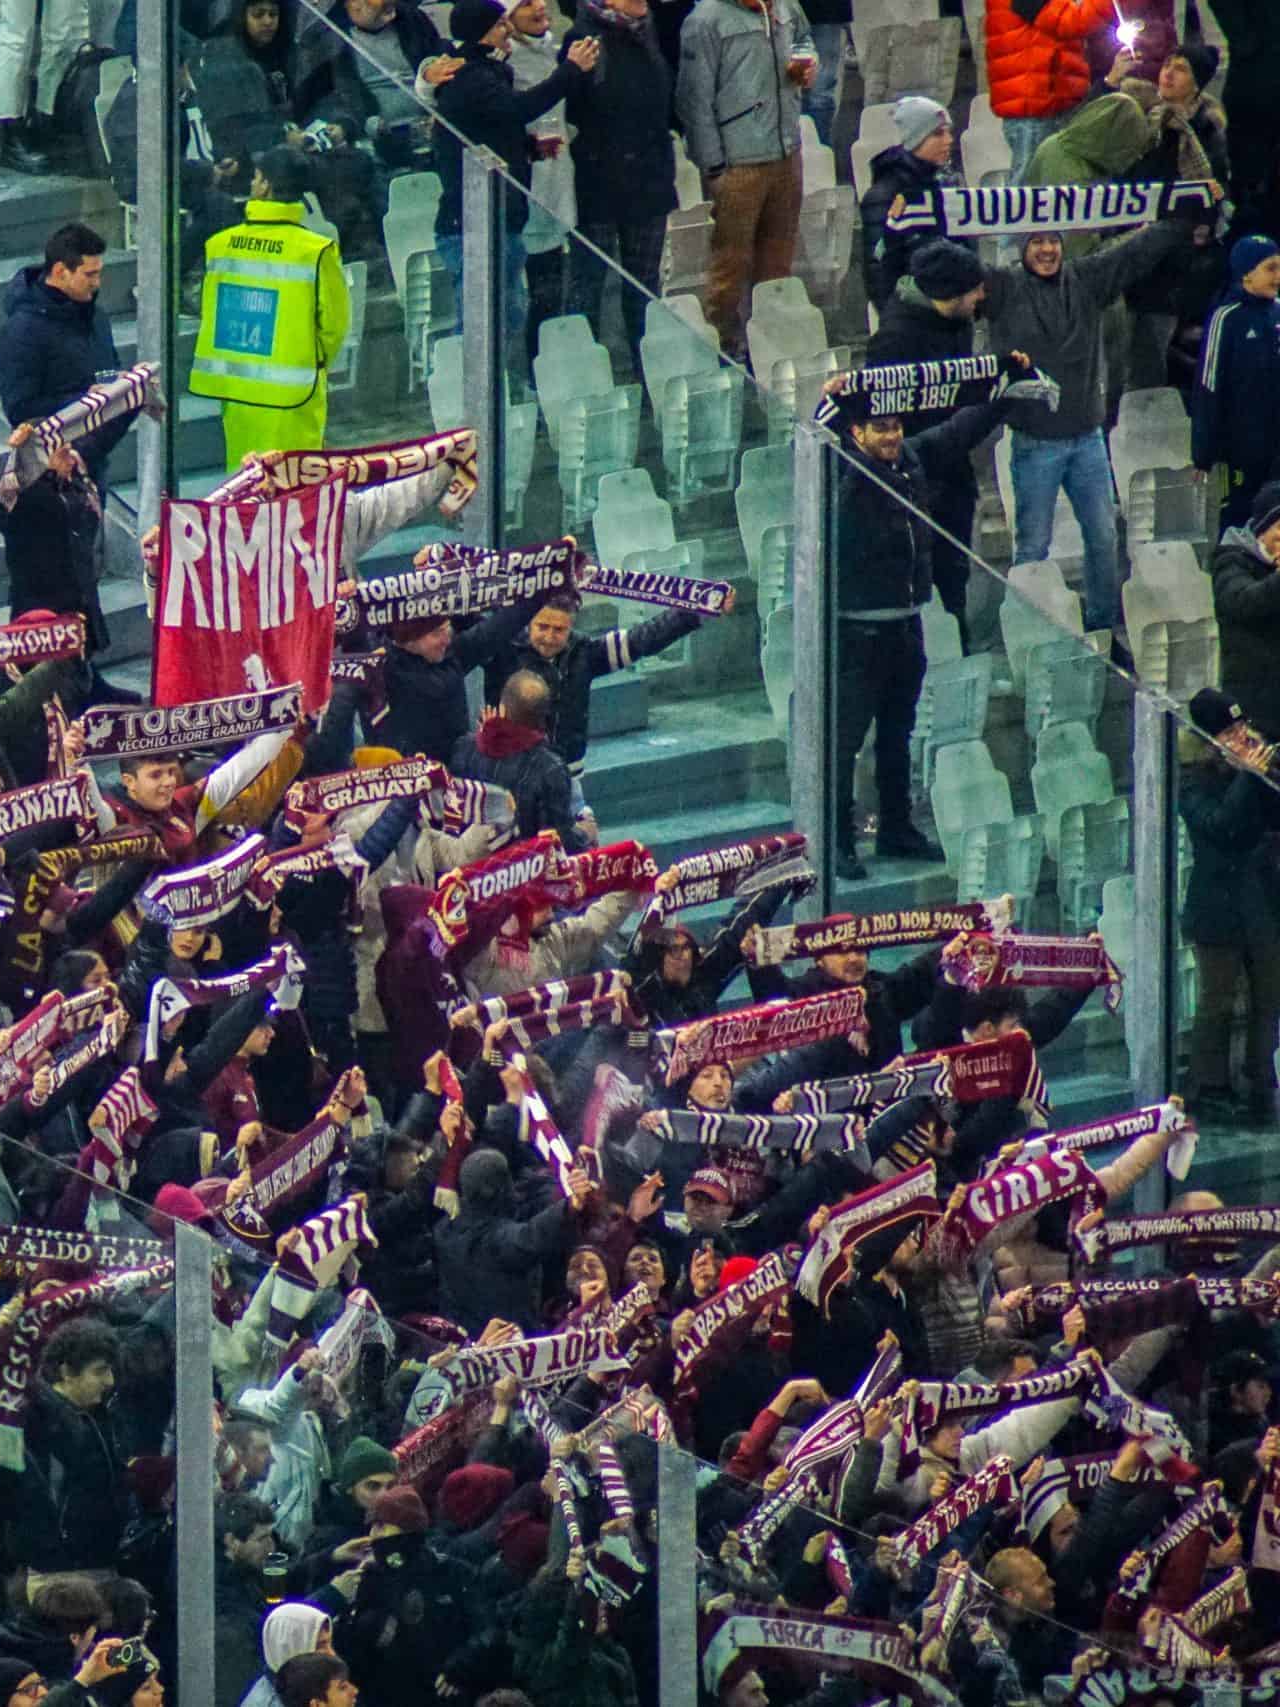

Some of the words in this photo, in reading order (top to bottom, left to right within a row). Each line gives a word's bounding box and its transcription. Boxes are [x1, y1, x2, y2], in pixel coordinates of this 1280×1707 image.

[957, 183, 1150, 227] JUVENTUS
[227, 235, 284, 256] JUVENTUS
[861, 363, 920, 393] PADRE
[923, 361, 943, 384] IN
[945, 355, 998, 383] FIGLIO
[870, 389, 915, 416] SINCE
[919, 383, 961, 412] 1897
[163, 479, 345, 632] RIMINI
[358, 566, 443, 603] TORINO
[476, 556, 501, 579] di
[507, 543, 570, 571] Padre
[367, 601, 394, 626] dal
[397, 593, 443, 622] 1906
[476, 582, 502, 602] in
[506, 569, 564, 600] Figlio
[10, 616, 78, 657] KORPS
[117, 735, 167, 753] VECCHIO
[170, 727, 209, 746] CUORE
[212, 719, 265, 738] GRANATA
[125, 698, 265, 739] TORINO
[322, 776, 432, 811] GRANATA
[469, 852, 545, 903] TORINO
[679, 850, 713, 883] PADRE
[723, 844, 754, 874] FIGLIO
[683, 878, 721, 906] SEMPRE
[804, 923, 858, 952] GRAZIE
[860, 920, 871, 936] A
[871, 915, 897, 935] DIO
[899, 912, 931, 933] NON
[954, 1051, 1013, 1078] Granata
[1119, 1113, 1154, 1136] FORZA
[17, 1237, 93, 1263] ALDO
[1080, 1279, 1160, 1293] VECCHIO
[945, 1382, 1001, 1410] ALE
[1008, 1365, 1082, 1405] TORO
[758, 1618, 825, 1651] FORZA
